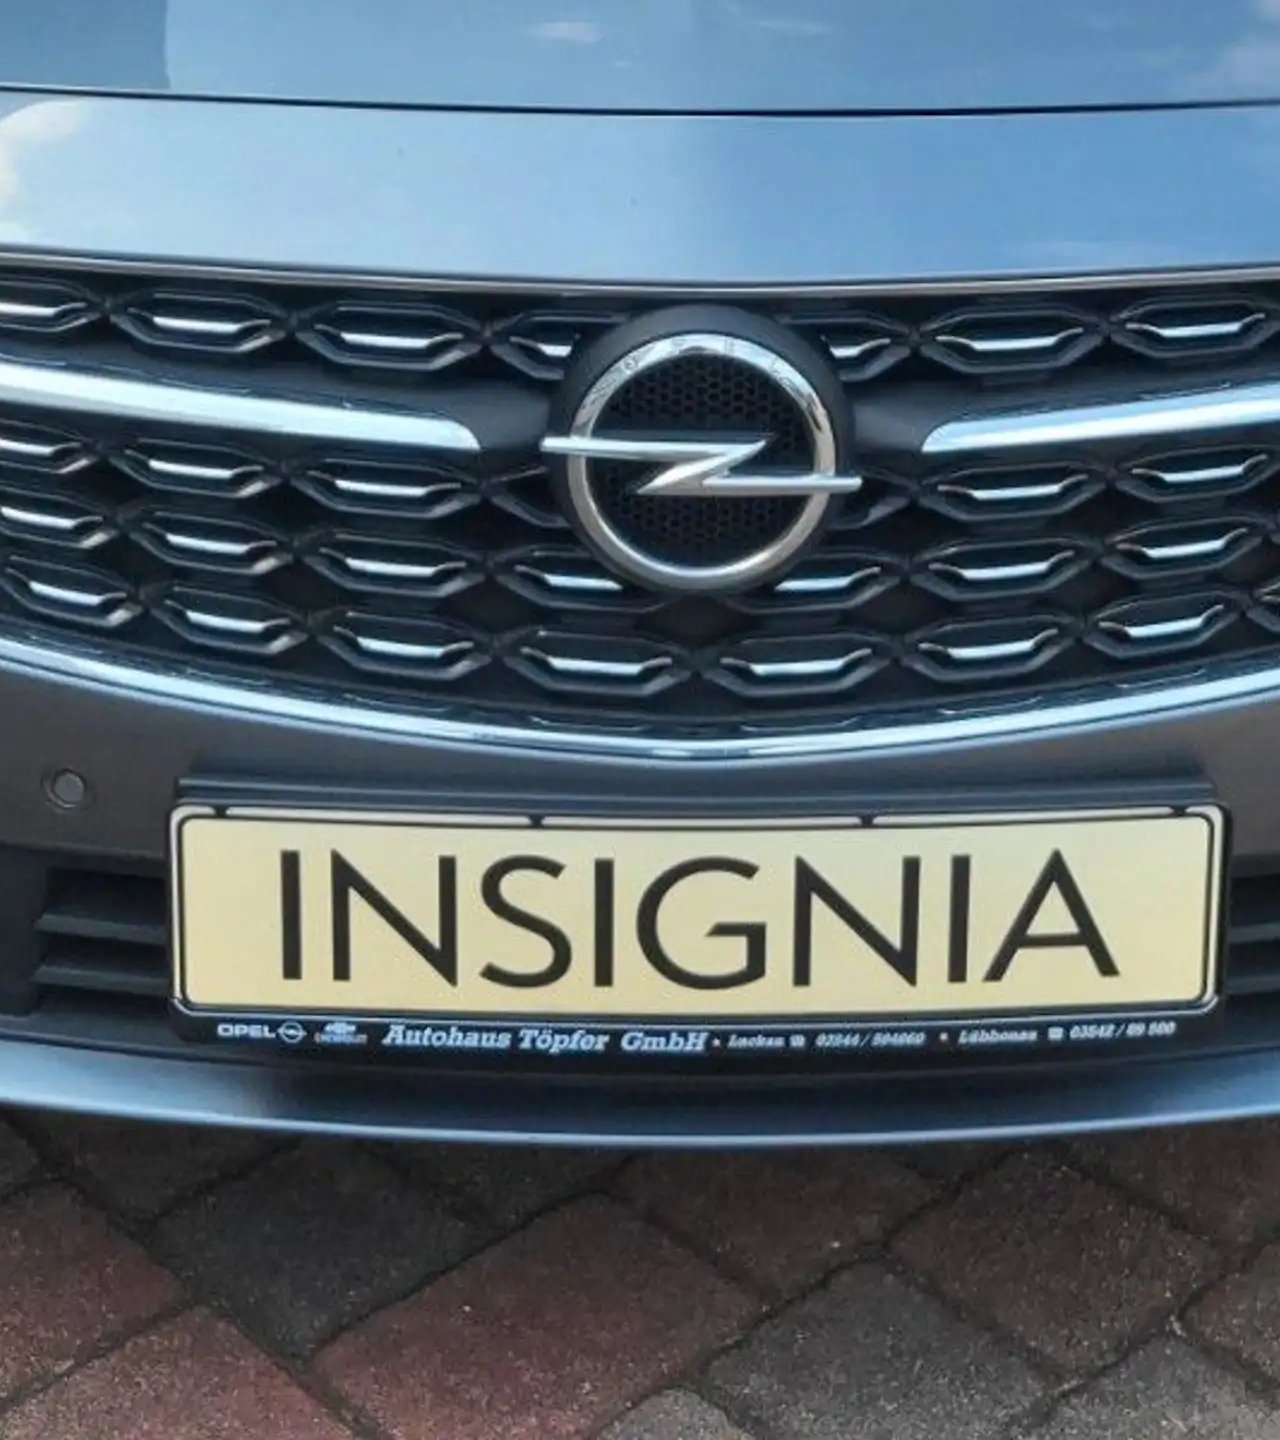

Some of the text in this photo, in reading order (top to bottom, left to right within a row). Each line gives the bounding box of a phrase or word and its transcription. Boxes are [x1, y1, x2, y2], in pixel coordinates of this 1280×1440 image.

[279, 847, 1122, 990] INSIGNIA
[217, 1023, 276, 1038] OPEL
[381, 1021, 512, 1048] Autohaus
[519, 1028, 610, 1054] Töpfer
[620, 1030, 709, 1052] GmbH
